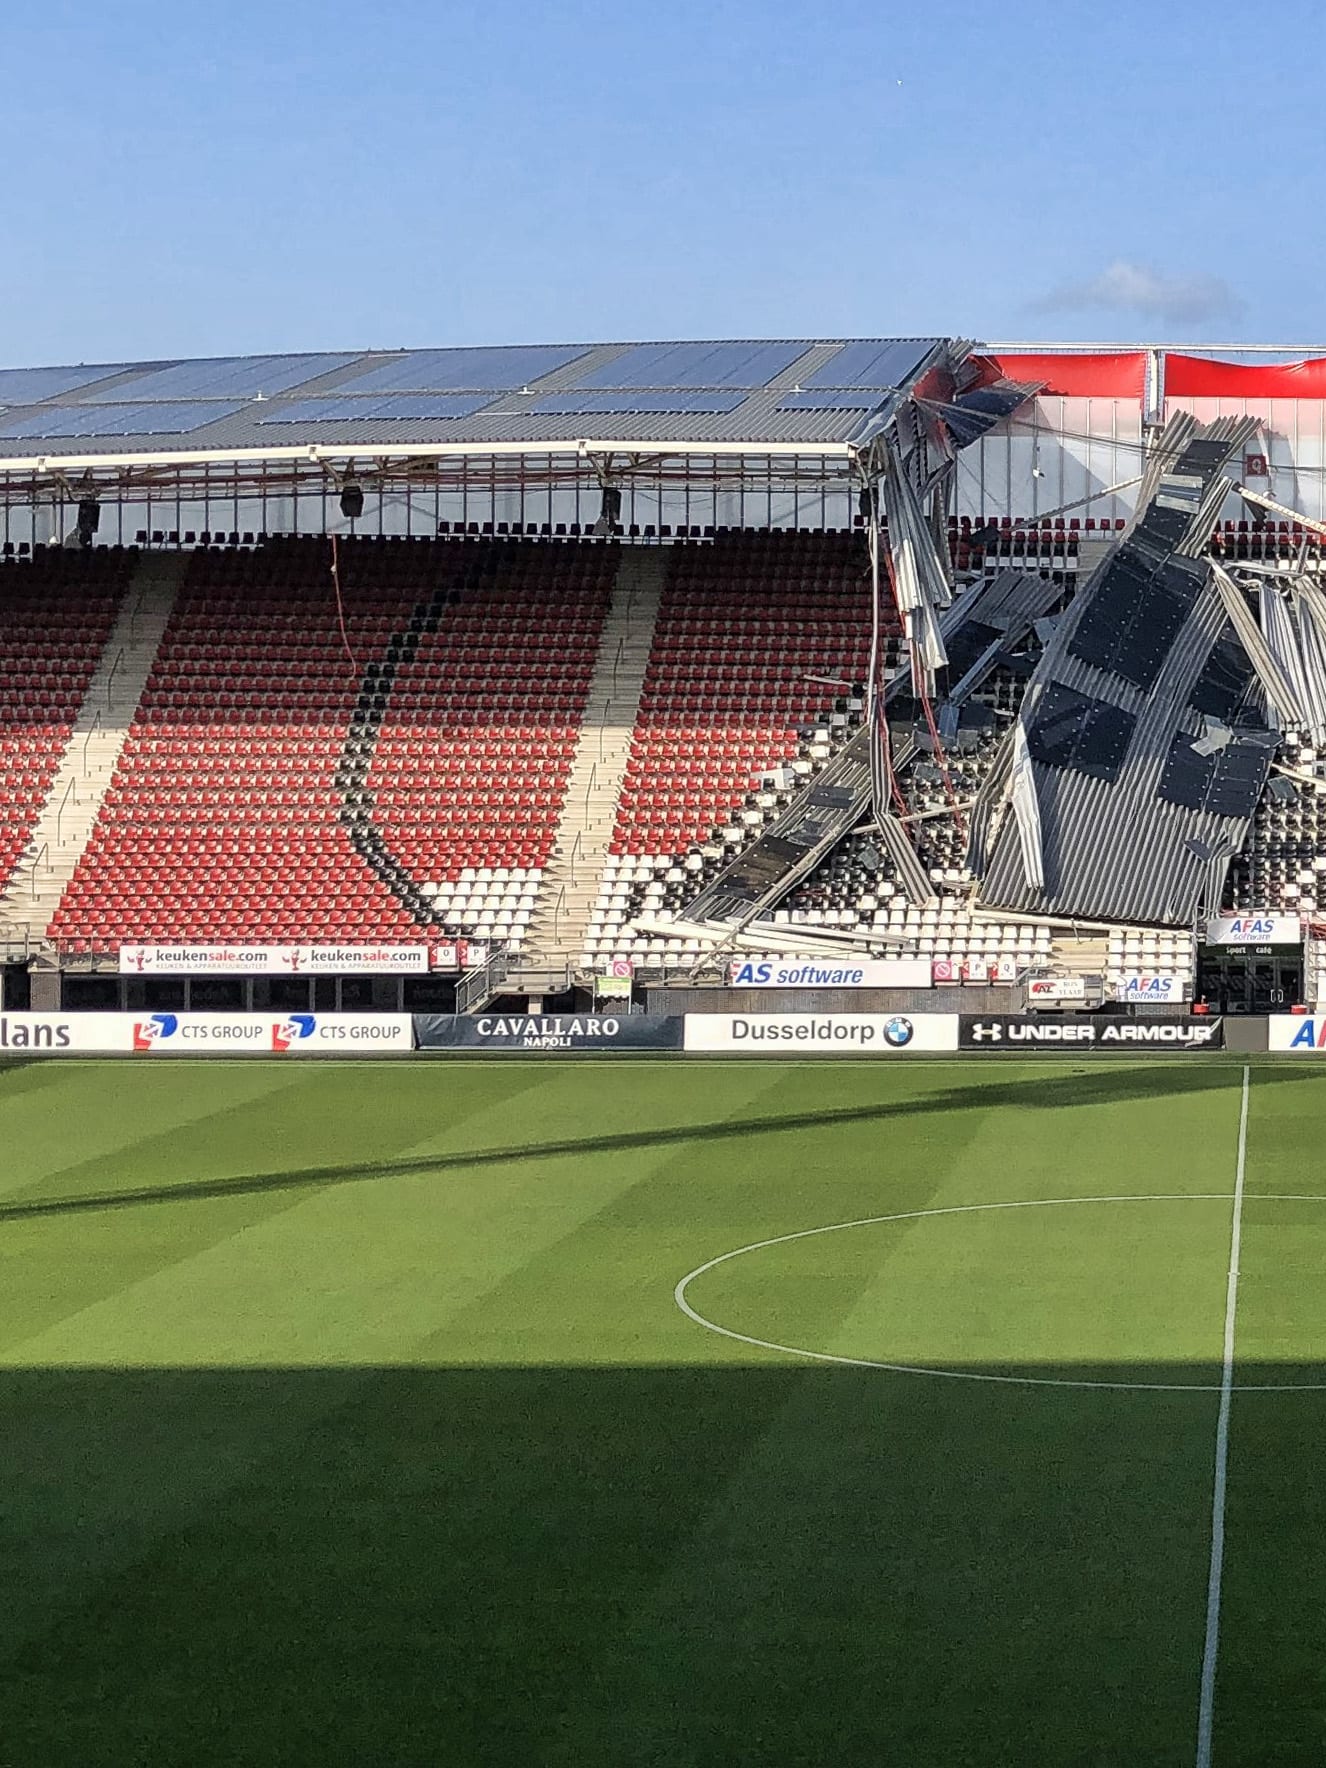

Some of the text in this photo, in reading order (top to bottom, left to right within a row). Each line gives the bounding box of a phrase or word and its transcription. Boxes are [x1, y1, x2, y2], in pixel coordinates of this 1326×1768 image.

[1230, 919, 1275, 933] AFAS
[1233, 932, 1271, 941] software
[156, 949, 268, 961] keukensale.com
[311, 949, 421, 961] keukensale.com
[776, 966, 864, 983] software
[1127, 978, 1173, 992] AFAS
[1129, 991, 1169, 1000] software
[1, 1018, 70, 1047] lans
[182, 1026, 263, 1038] CTS GROUP
[320, 1026, 401, 1039] CTS GROUP
[476, 1018, 620, 1036] CAVALLARO
[732, 1019, 875, 1044] Dusseldorp
[1008, 1025, 1212, 1041] UNDER ARMOUR
[524, 1036, 571, 1047] NAPOLI
